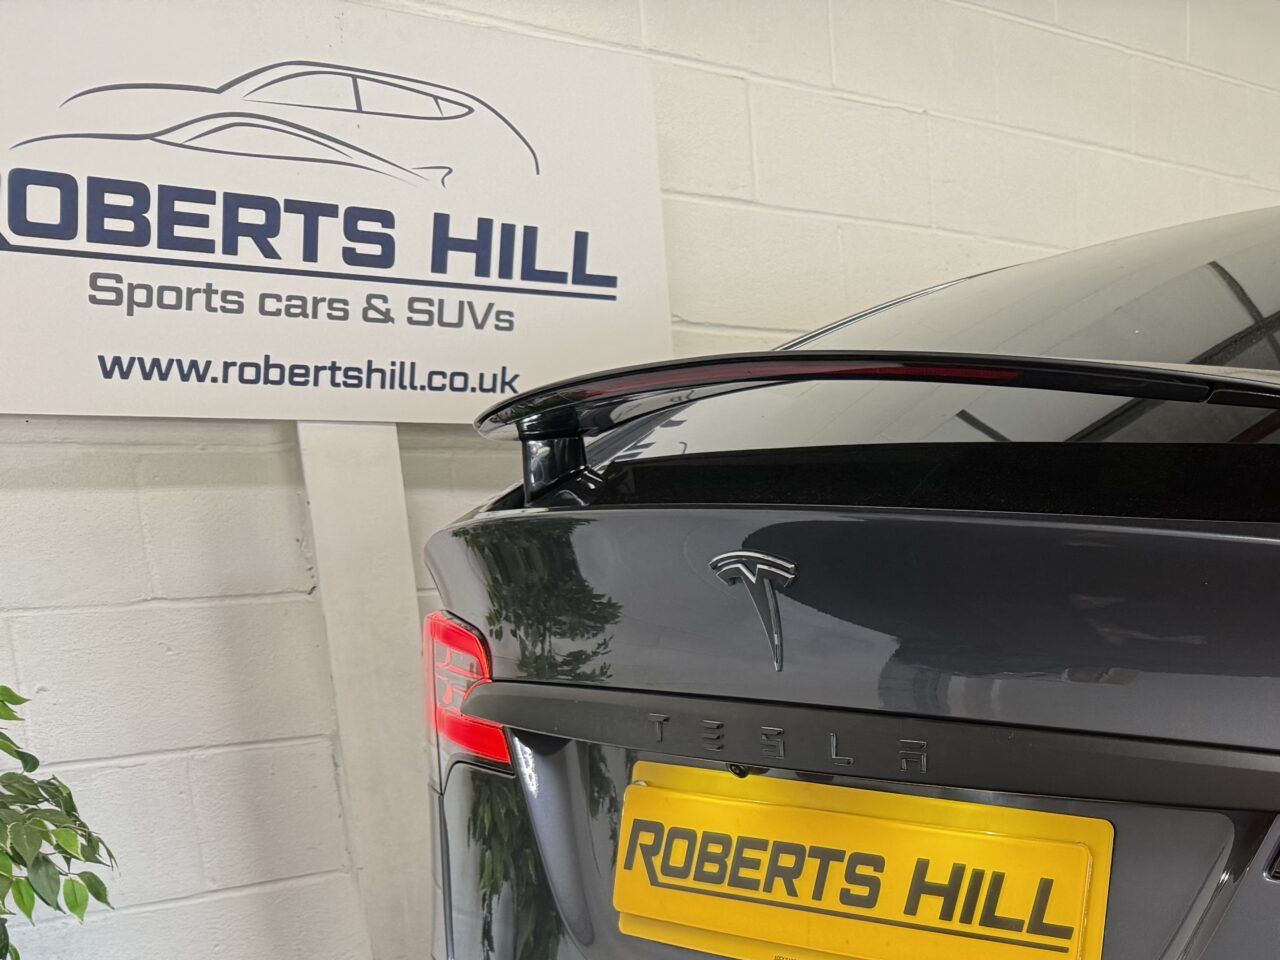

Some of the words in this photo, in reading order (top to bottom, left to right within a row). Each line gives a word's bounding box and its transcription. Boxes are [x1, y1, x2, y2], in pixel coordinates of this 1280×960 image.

[0, 168, 396, 269] OBERTS
[430, 212, 618, 288] HILL
[88, 272, 244, 317] Sports
[258, 291, 350, 322] cars
[361, 293, 395, 324] &
[406, 298, 515, 332] SUVs
[97, 354, 519, 394] www.robertshill.co.uk
[649, 712, 928, 774] TESLA
[623, 818, 886, 909] ROBERTS
[903, 857, 1075, 941] HILL
